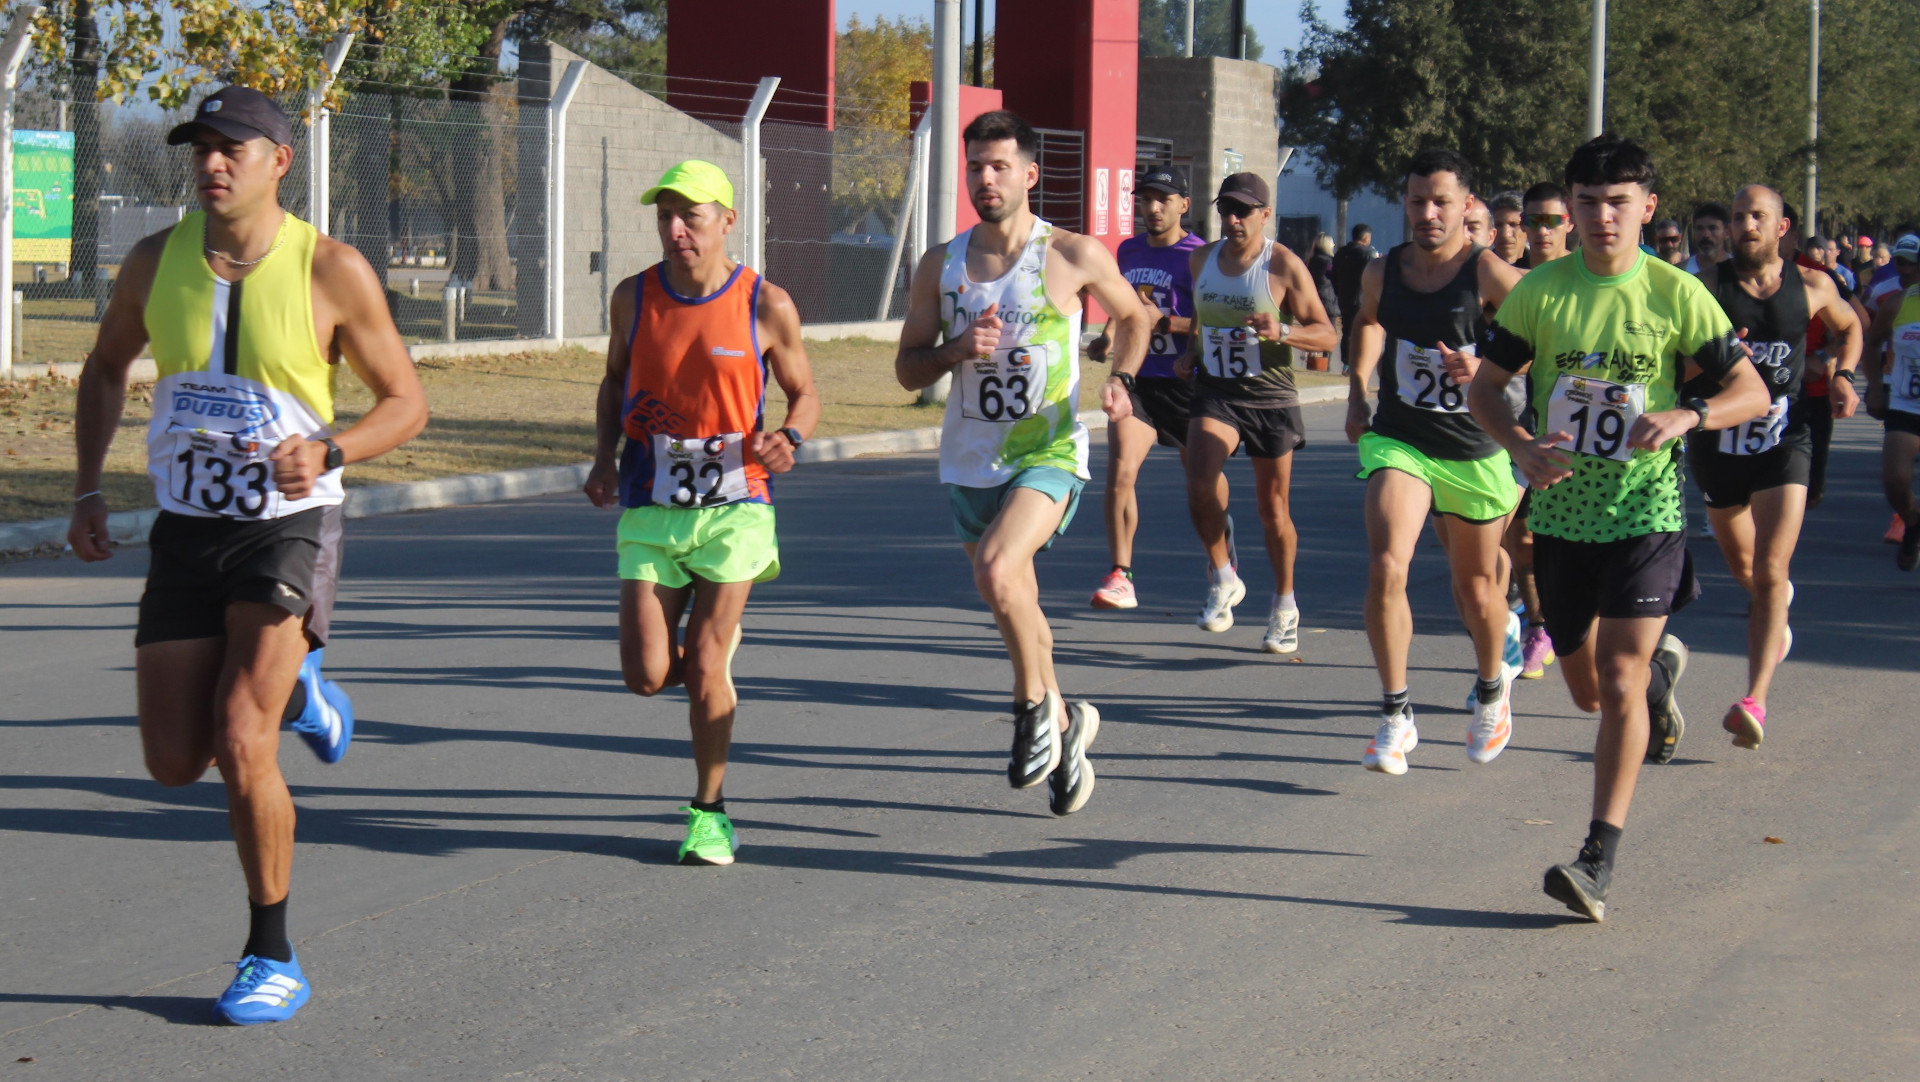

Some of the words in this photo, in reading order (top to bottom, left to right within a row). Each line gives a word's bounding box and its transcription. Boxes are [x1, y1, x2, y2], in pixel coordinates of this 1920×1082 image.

[1212, 346, 1248, 377] 15
[175, 397, 263, 422] DUBUS
[179, 383, 226, 394] TEAM
[980, 374, 1029, 420] 63
[1414, 368, 1463, 411] 28
[1570, 405, 1626, 458] 19
[178, 449, 270, 517] 133
[670, 462, 727, 508] 32
